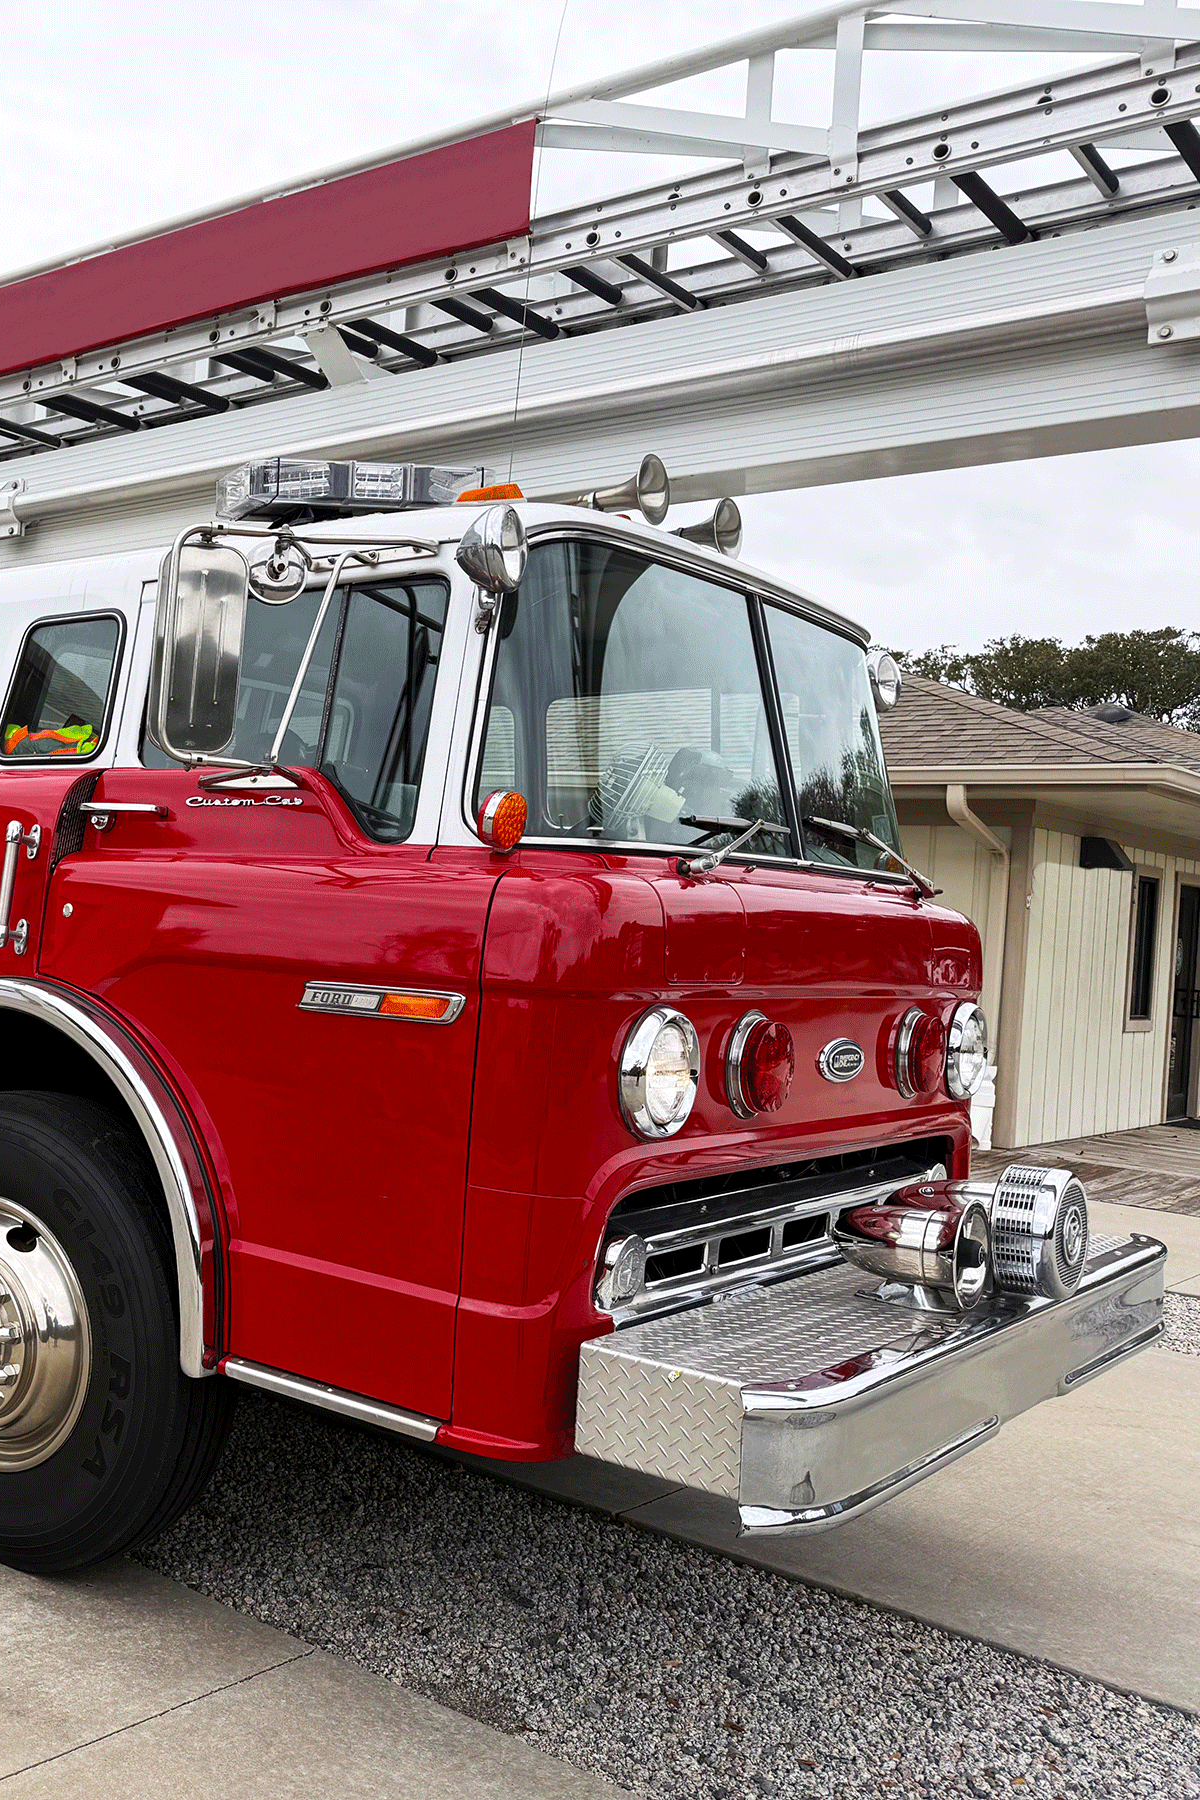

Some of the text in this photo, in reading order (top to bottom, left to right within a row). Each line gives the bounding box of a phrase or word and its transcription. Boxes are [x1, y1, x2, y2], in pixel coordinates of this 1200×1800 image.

[185, 795, 303, 807] Custom Cab
[309, 991, 352, 1005] FORD
[50, 1187, 133, 1481] G149 RSA
